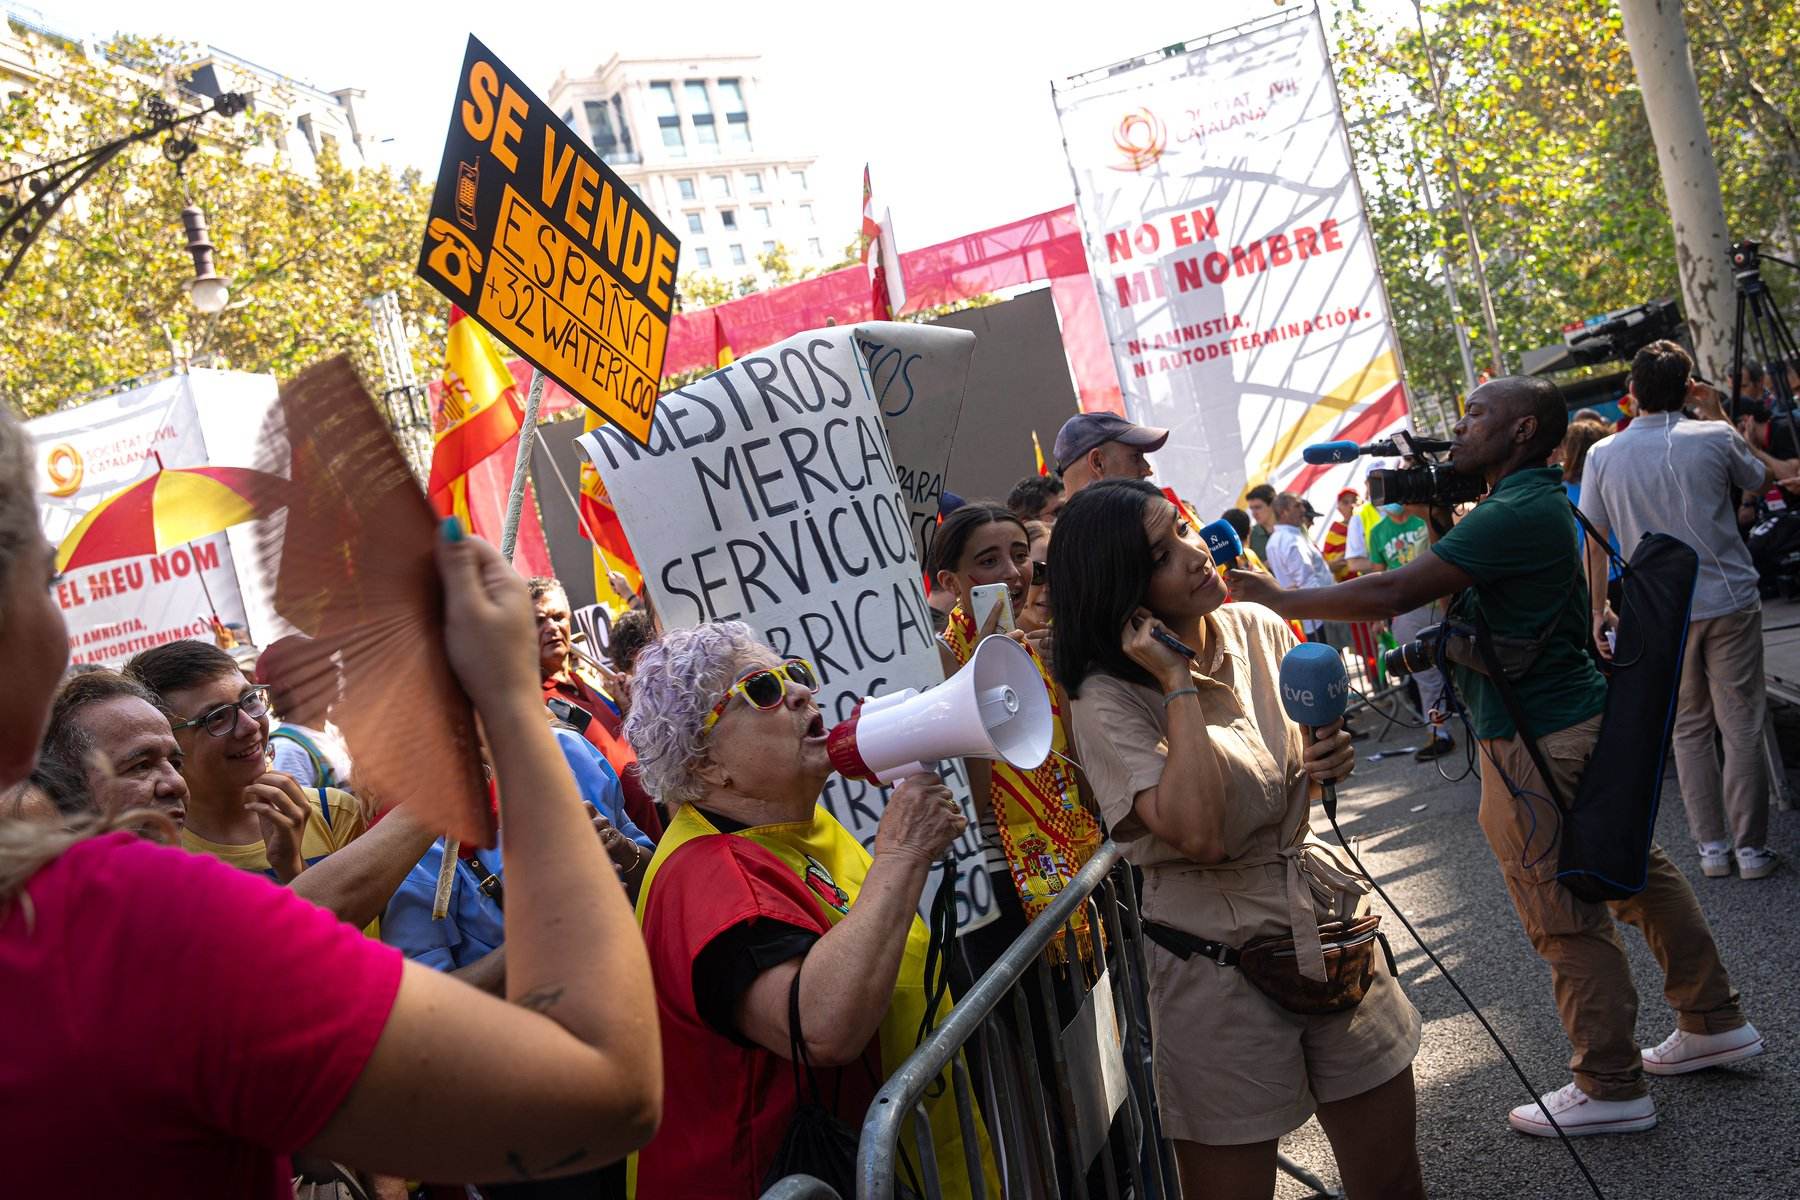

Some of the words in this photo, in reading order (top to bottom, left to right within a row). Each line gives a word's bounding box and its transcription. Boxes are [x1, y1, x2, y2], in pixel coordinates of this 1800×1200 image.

[462, 60, 529, 175] SE
[541, 123, 677, 313] VENDE
[1104, 223, 1160, 264] NO
[1170, 206, 1219, 248] EN
[1115, 266, 1167, 309] MI
[1174, 219, 1344, 293] NOMBRE
[502, 189, 654, 369] ESPAÑA
[542, 294, 654, 421] WATERLOO
[1127, 339, 1148, 357] NI
[1154, 313, 1250, 349] AMNISTÍA,
[1133, 362, 1153, 379] NI
[1159, 306, 1372, 371] AUTODETERMINACIÓN.
[595, 338, 853, 471] NUESTROS
[57, 580, 85, 609] EL
[88, 562, 143, 601] MEU
[150, 542, 220, 583] NOM
[83, 617, 148, 645] AMNISTIA,
[1284, 683, 1315, 707] tve
